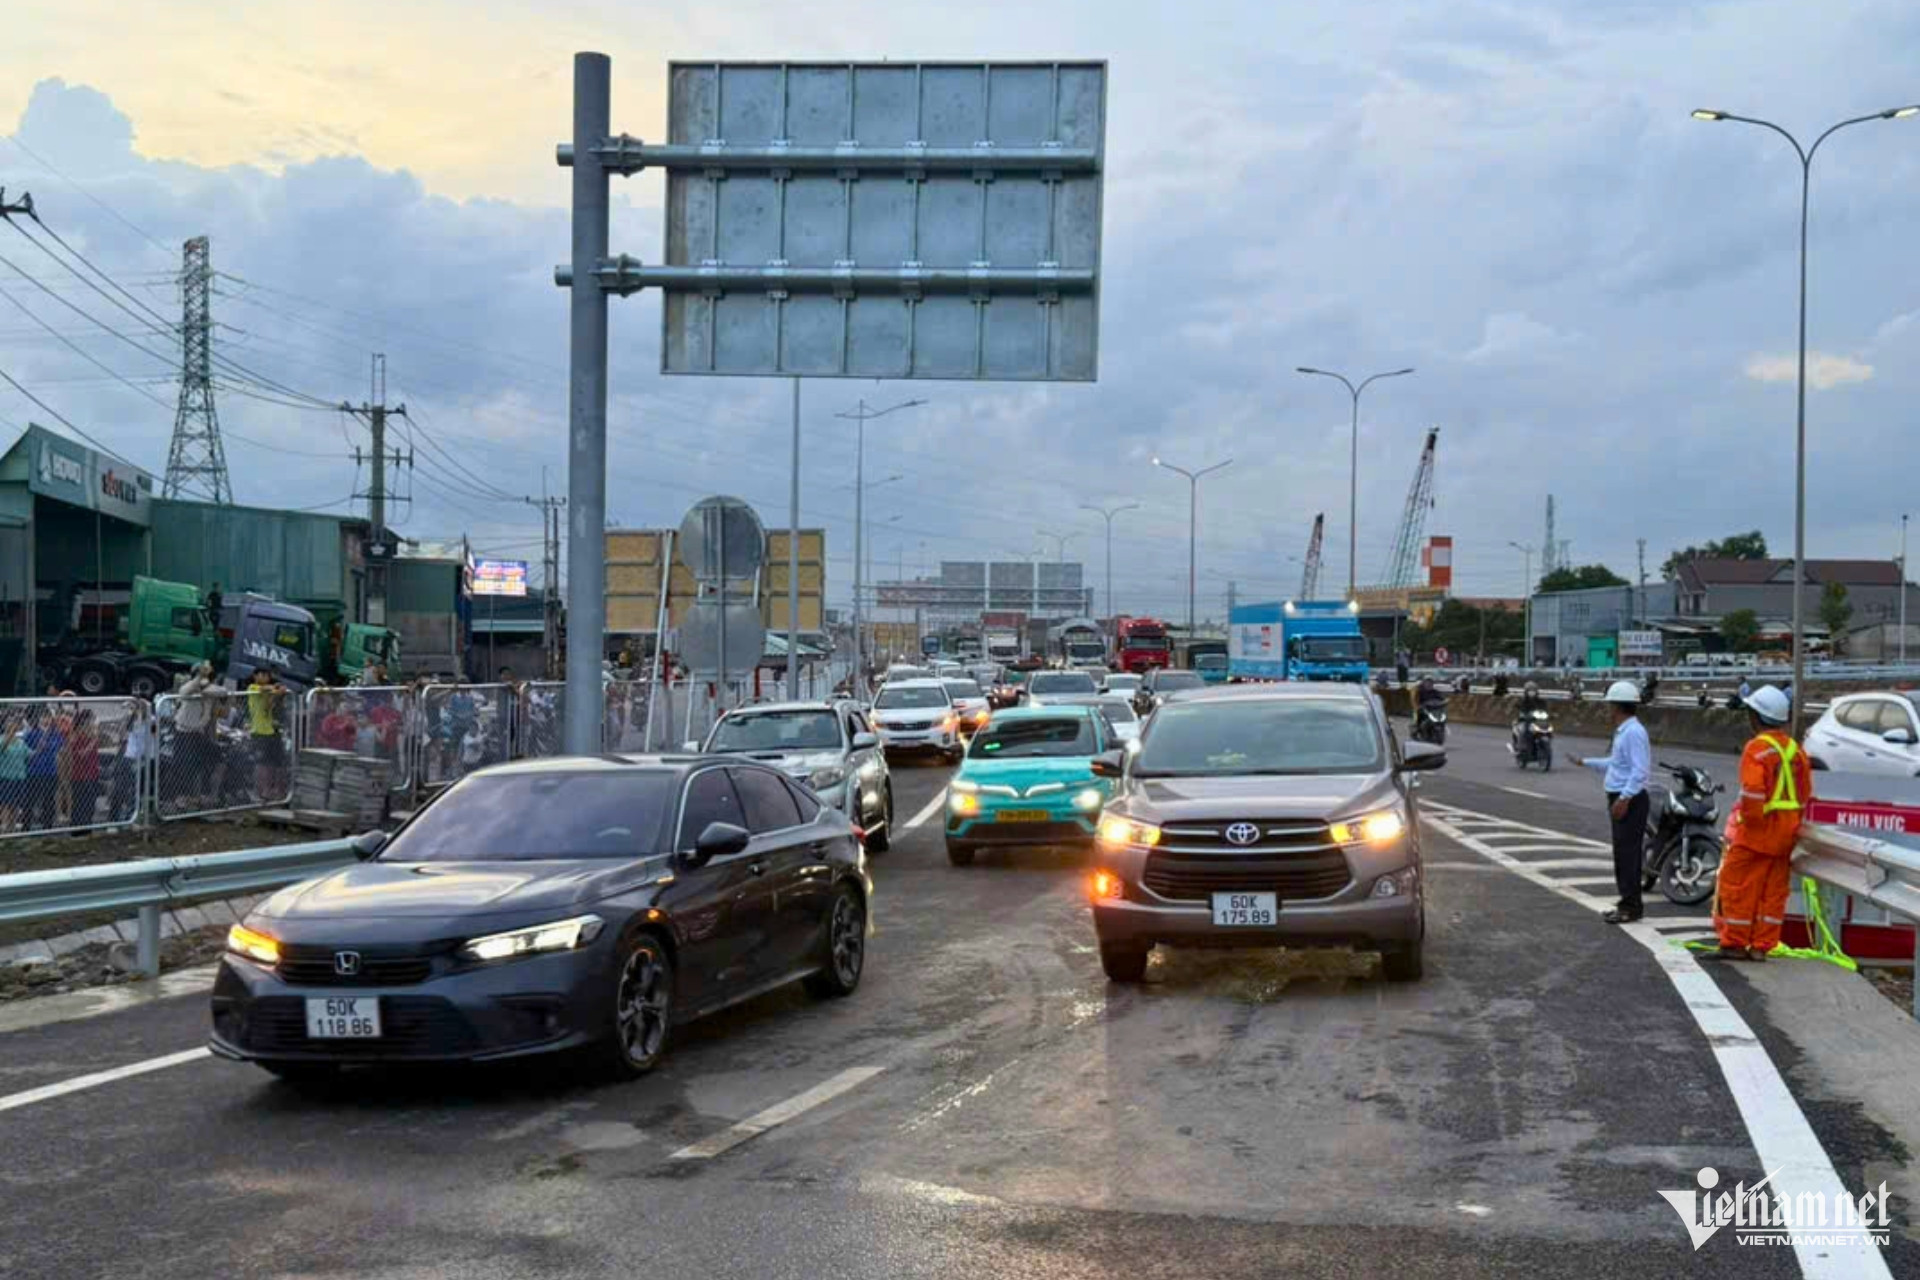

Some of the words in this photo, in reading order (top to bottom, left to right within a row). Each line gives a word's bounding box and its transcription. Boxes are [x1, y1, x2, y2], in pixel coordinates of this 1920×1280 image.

[1231, 895, 1257, 908] 60K
[1221, 909, 1270, 923] 175.89
[327, 998, 357, 1016] 60K
